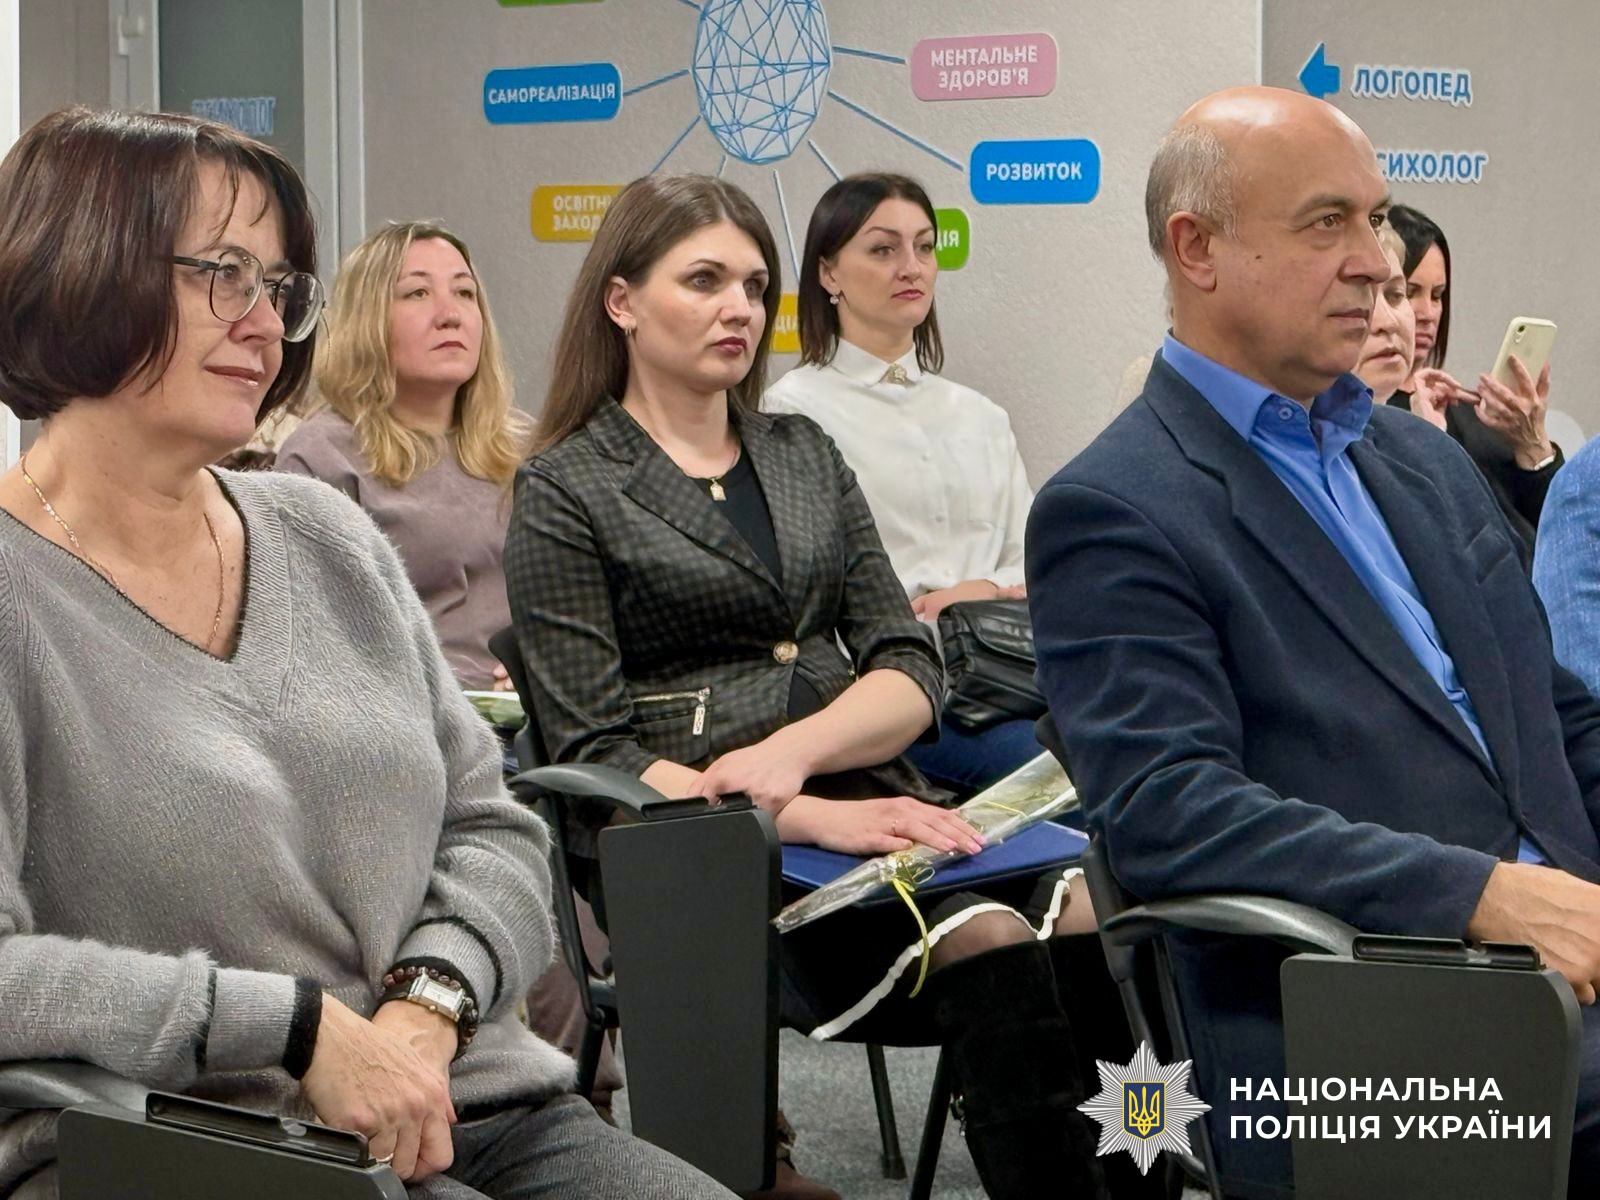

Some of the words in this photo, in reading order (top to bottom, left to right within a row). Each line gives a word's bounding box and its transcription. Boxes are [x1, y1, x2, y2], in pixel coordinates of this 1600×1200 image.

[931, 46, 1038, 67] МЕНТАЛЬНЕ
[938, 68, 1029, 91] ЗДОРОВ'Я
[1354, 68, 1472, 104] ЛОГОПЕД
[488, 82, 616, 105] САМОРЕАЛІЗАЦІЯ
[986, 162, 1082, 181] РОЗВИТОК
